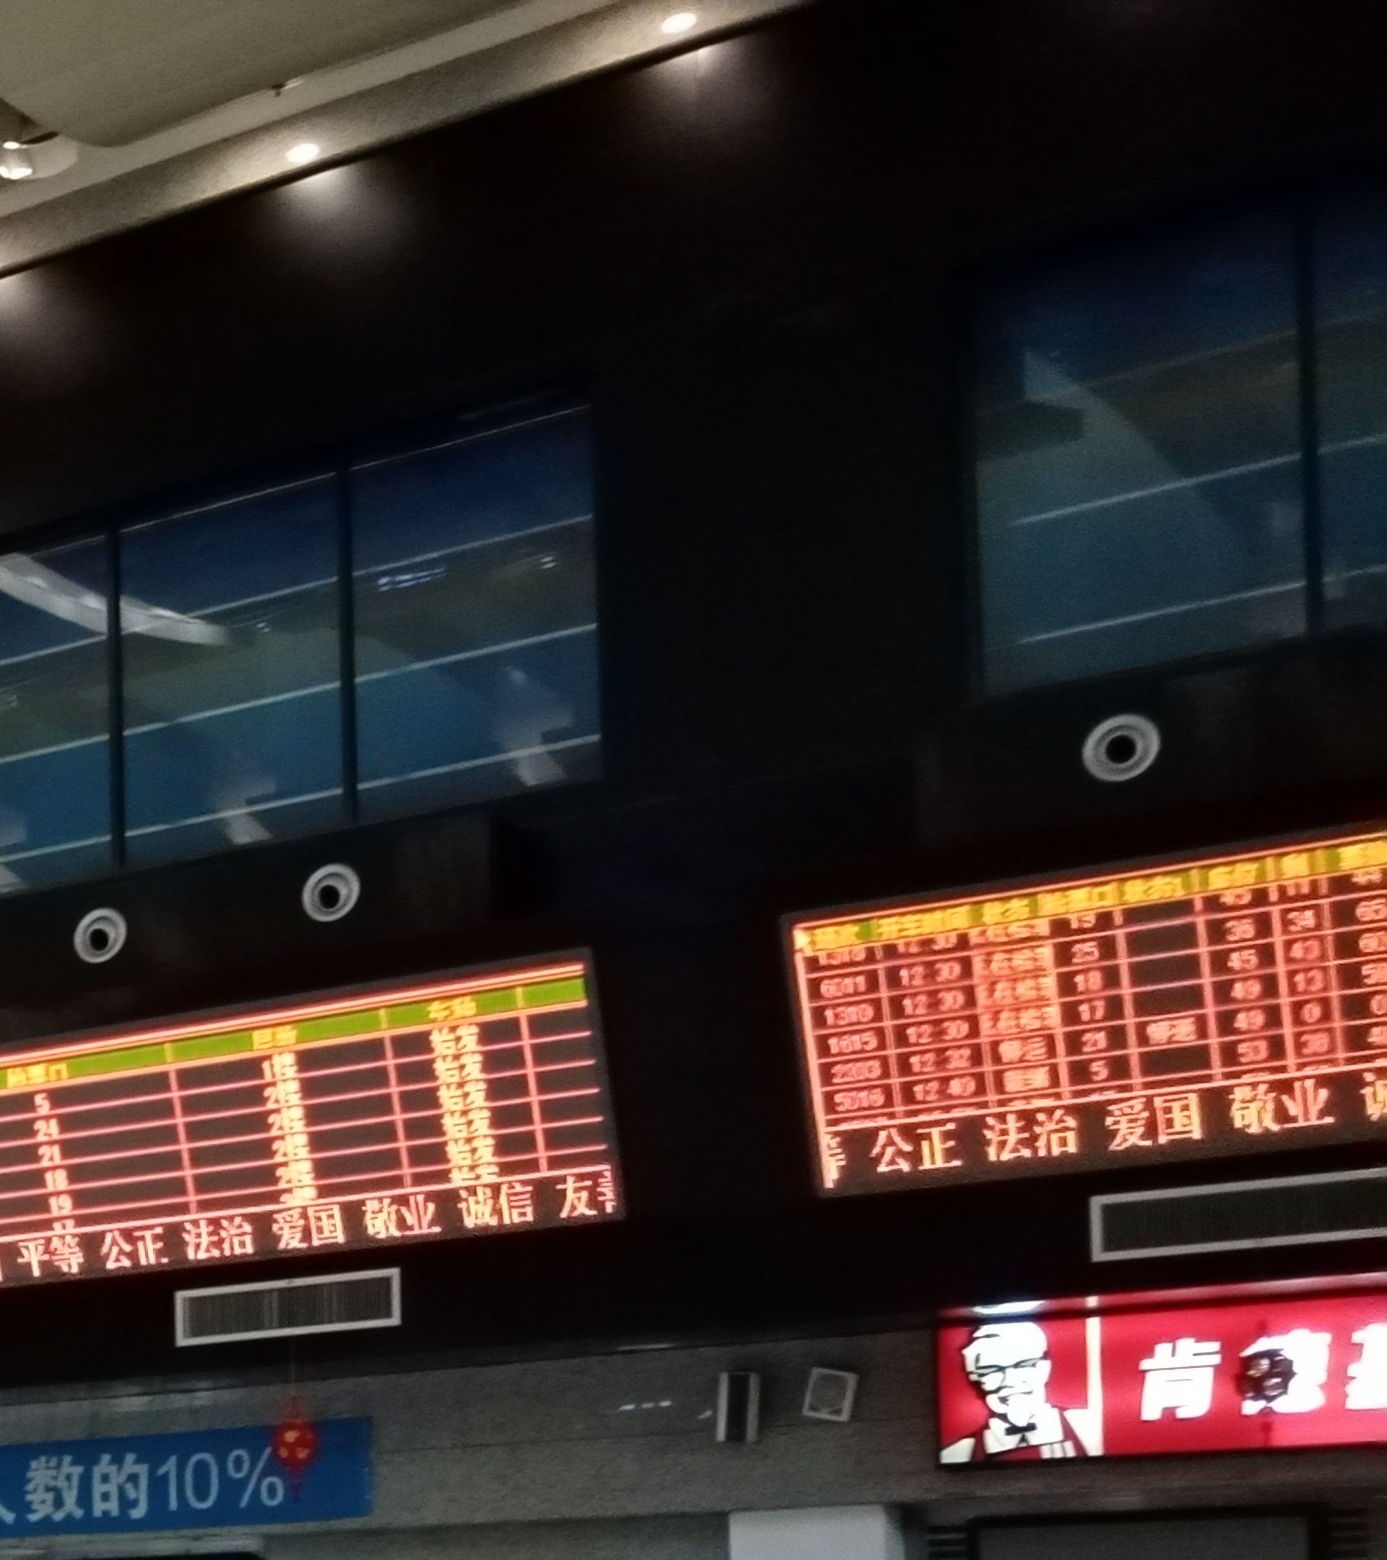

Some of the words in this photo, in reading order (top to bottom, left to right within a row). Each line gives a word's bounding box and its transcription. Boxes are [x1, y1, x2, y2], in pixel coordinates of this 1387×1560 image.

[33, 1118, 59, 1140] 24
[435, 1052, 483, 1083] 始发
[34, 1093, 51, 1114] 5
[430, 1023, 479, 1054] 始发
[38, 1144, 61, 1166] 21
[438, 1080, 487, 1112] 始发
[44, 1168, 69, 1190] 18
[442, 1109, 492, 1140] 始发
[445, 1136, 495, 1167] 始发
[870, 1125, 962, 1174] 公正
[984, 1110, 1077, 1162] 法治
[1105, 1092, 1204, 1152] 爱国
[1230, 1078, 1334, 1134] 敬业
[17, 1238, 84, 1278] 平等
[100, 1225, 169, 1271] 公正
[183, 1216, 255, 1264] 法治
[272, 1204, 345, 1253] 爱国
[362, 1196, 439, 1240] 敬业
[457, 1182, 535, 1228] 诚信
